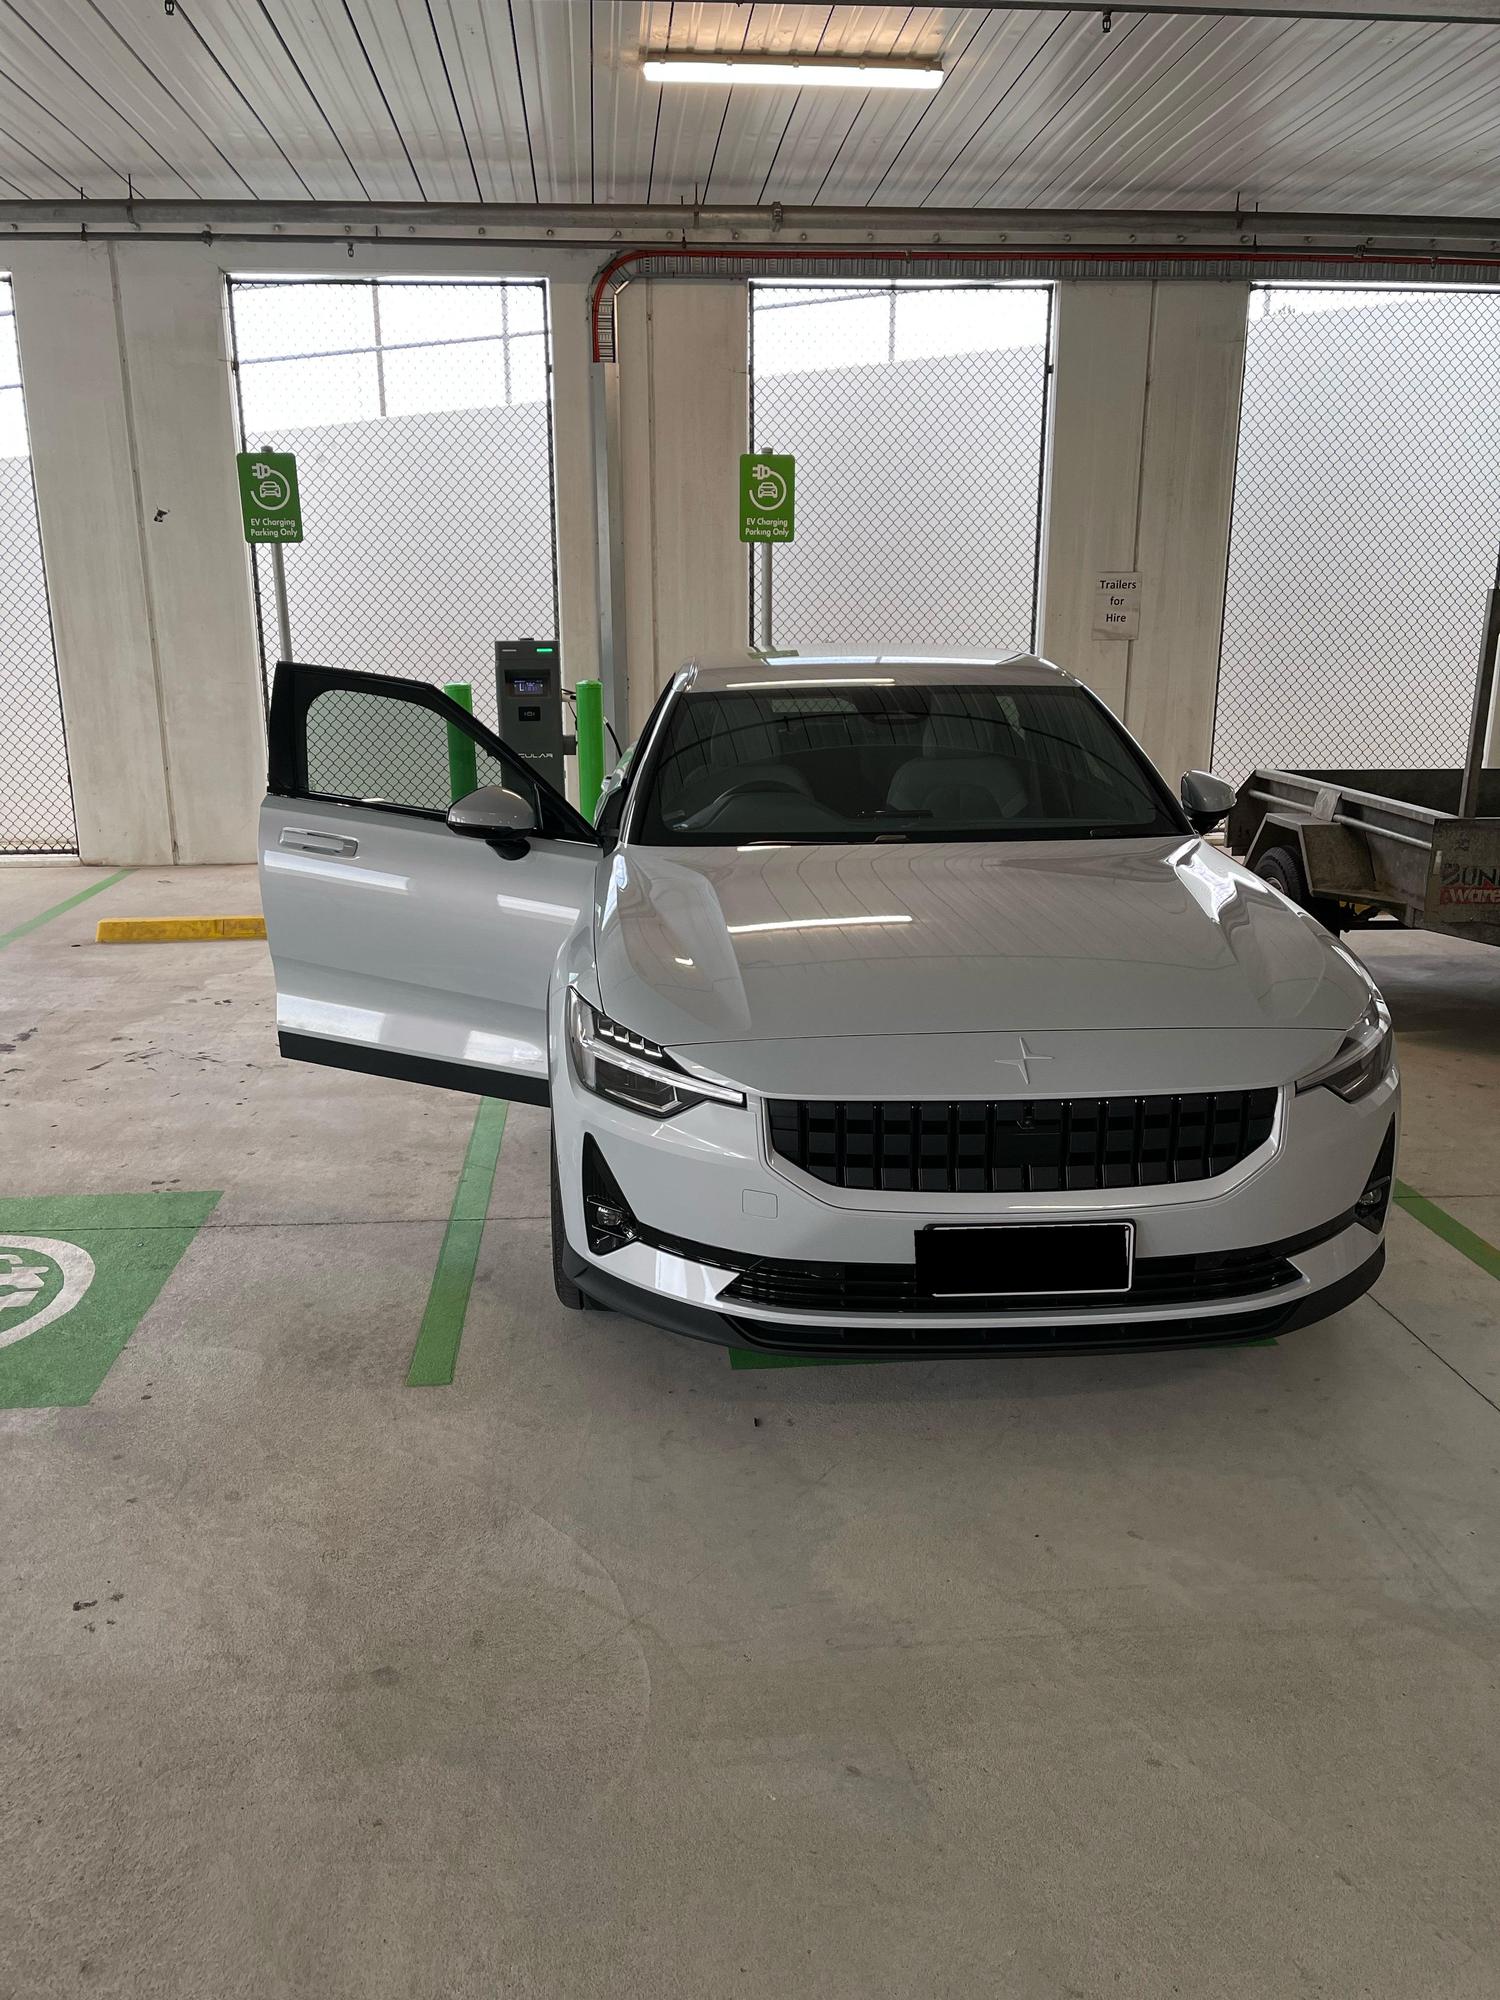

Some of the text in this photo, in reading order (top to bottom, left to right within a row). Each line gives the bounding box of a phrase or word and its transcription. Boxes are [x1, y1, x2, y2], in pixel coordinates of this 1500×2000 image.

[251, 518, 295, 527] EV Charging
[756, 517, 788, 527] Charging
[250, 528, 298, 538] Parking Only
[745, 527, 789, 537] Parking Only
[1100, 580, 1137, 589] Trailers
[1110, 596, 1125, 606] for
[1105, 613, 1127, 623] Hire
